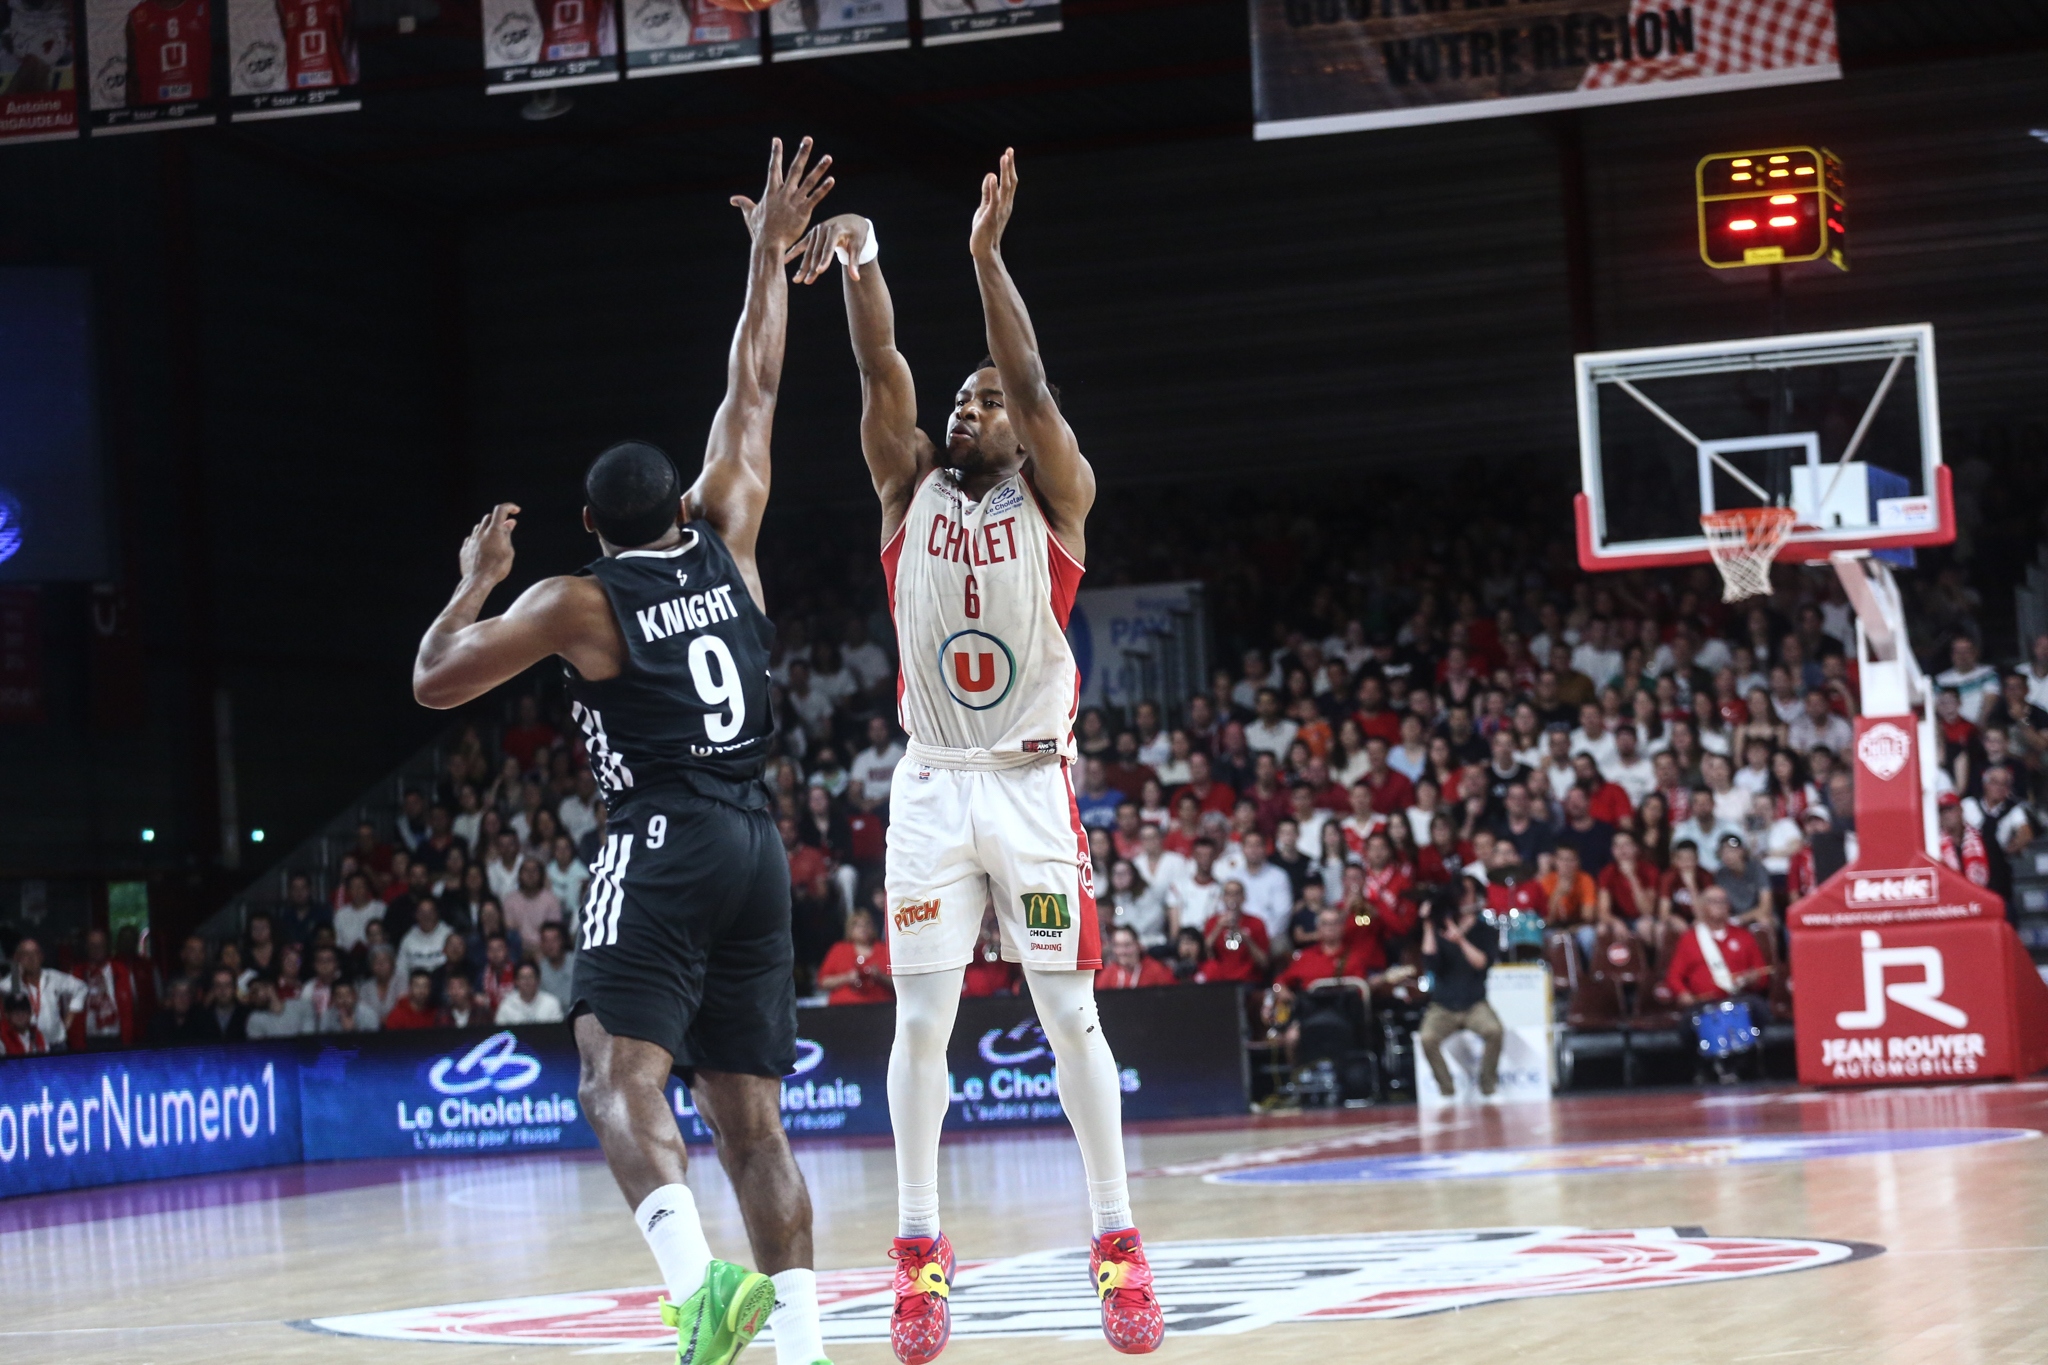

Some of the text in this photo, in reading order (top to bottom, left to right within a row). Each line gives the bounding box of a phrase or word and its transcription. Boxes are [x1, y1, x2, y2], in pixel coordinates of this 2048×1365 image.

[1384, 28, 1520, 85] VOTRE
[5, 98, 62, 116] Antoine
[927, 513, 1020, 567] CHOLET
[635, 583, 739, 644] KNIGHT
[964, 574, 981, 619] 6
[687, 634, 746, 744] 9
[953, 652, 995, 693] U
[645, 813, 668, 850] 9
[1029, 929, 1063, 938] CHOLET
[1030, 942, 1062, 952] SPALDING
[1822, 1033, 1986, 1066] JEAN ROUYER
[1832, 1055, 1978, 1080] AUTOMOBILES
[949, 1072, 984, 1102] Le
[397, 1093, 578, 1131] Le Choletais
